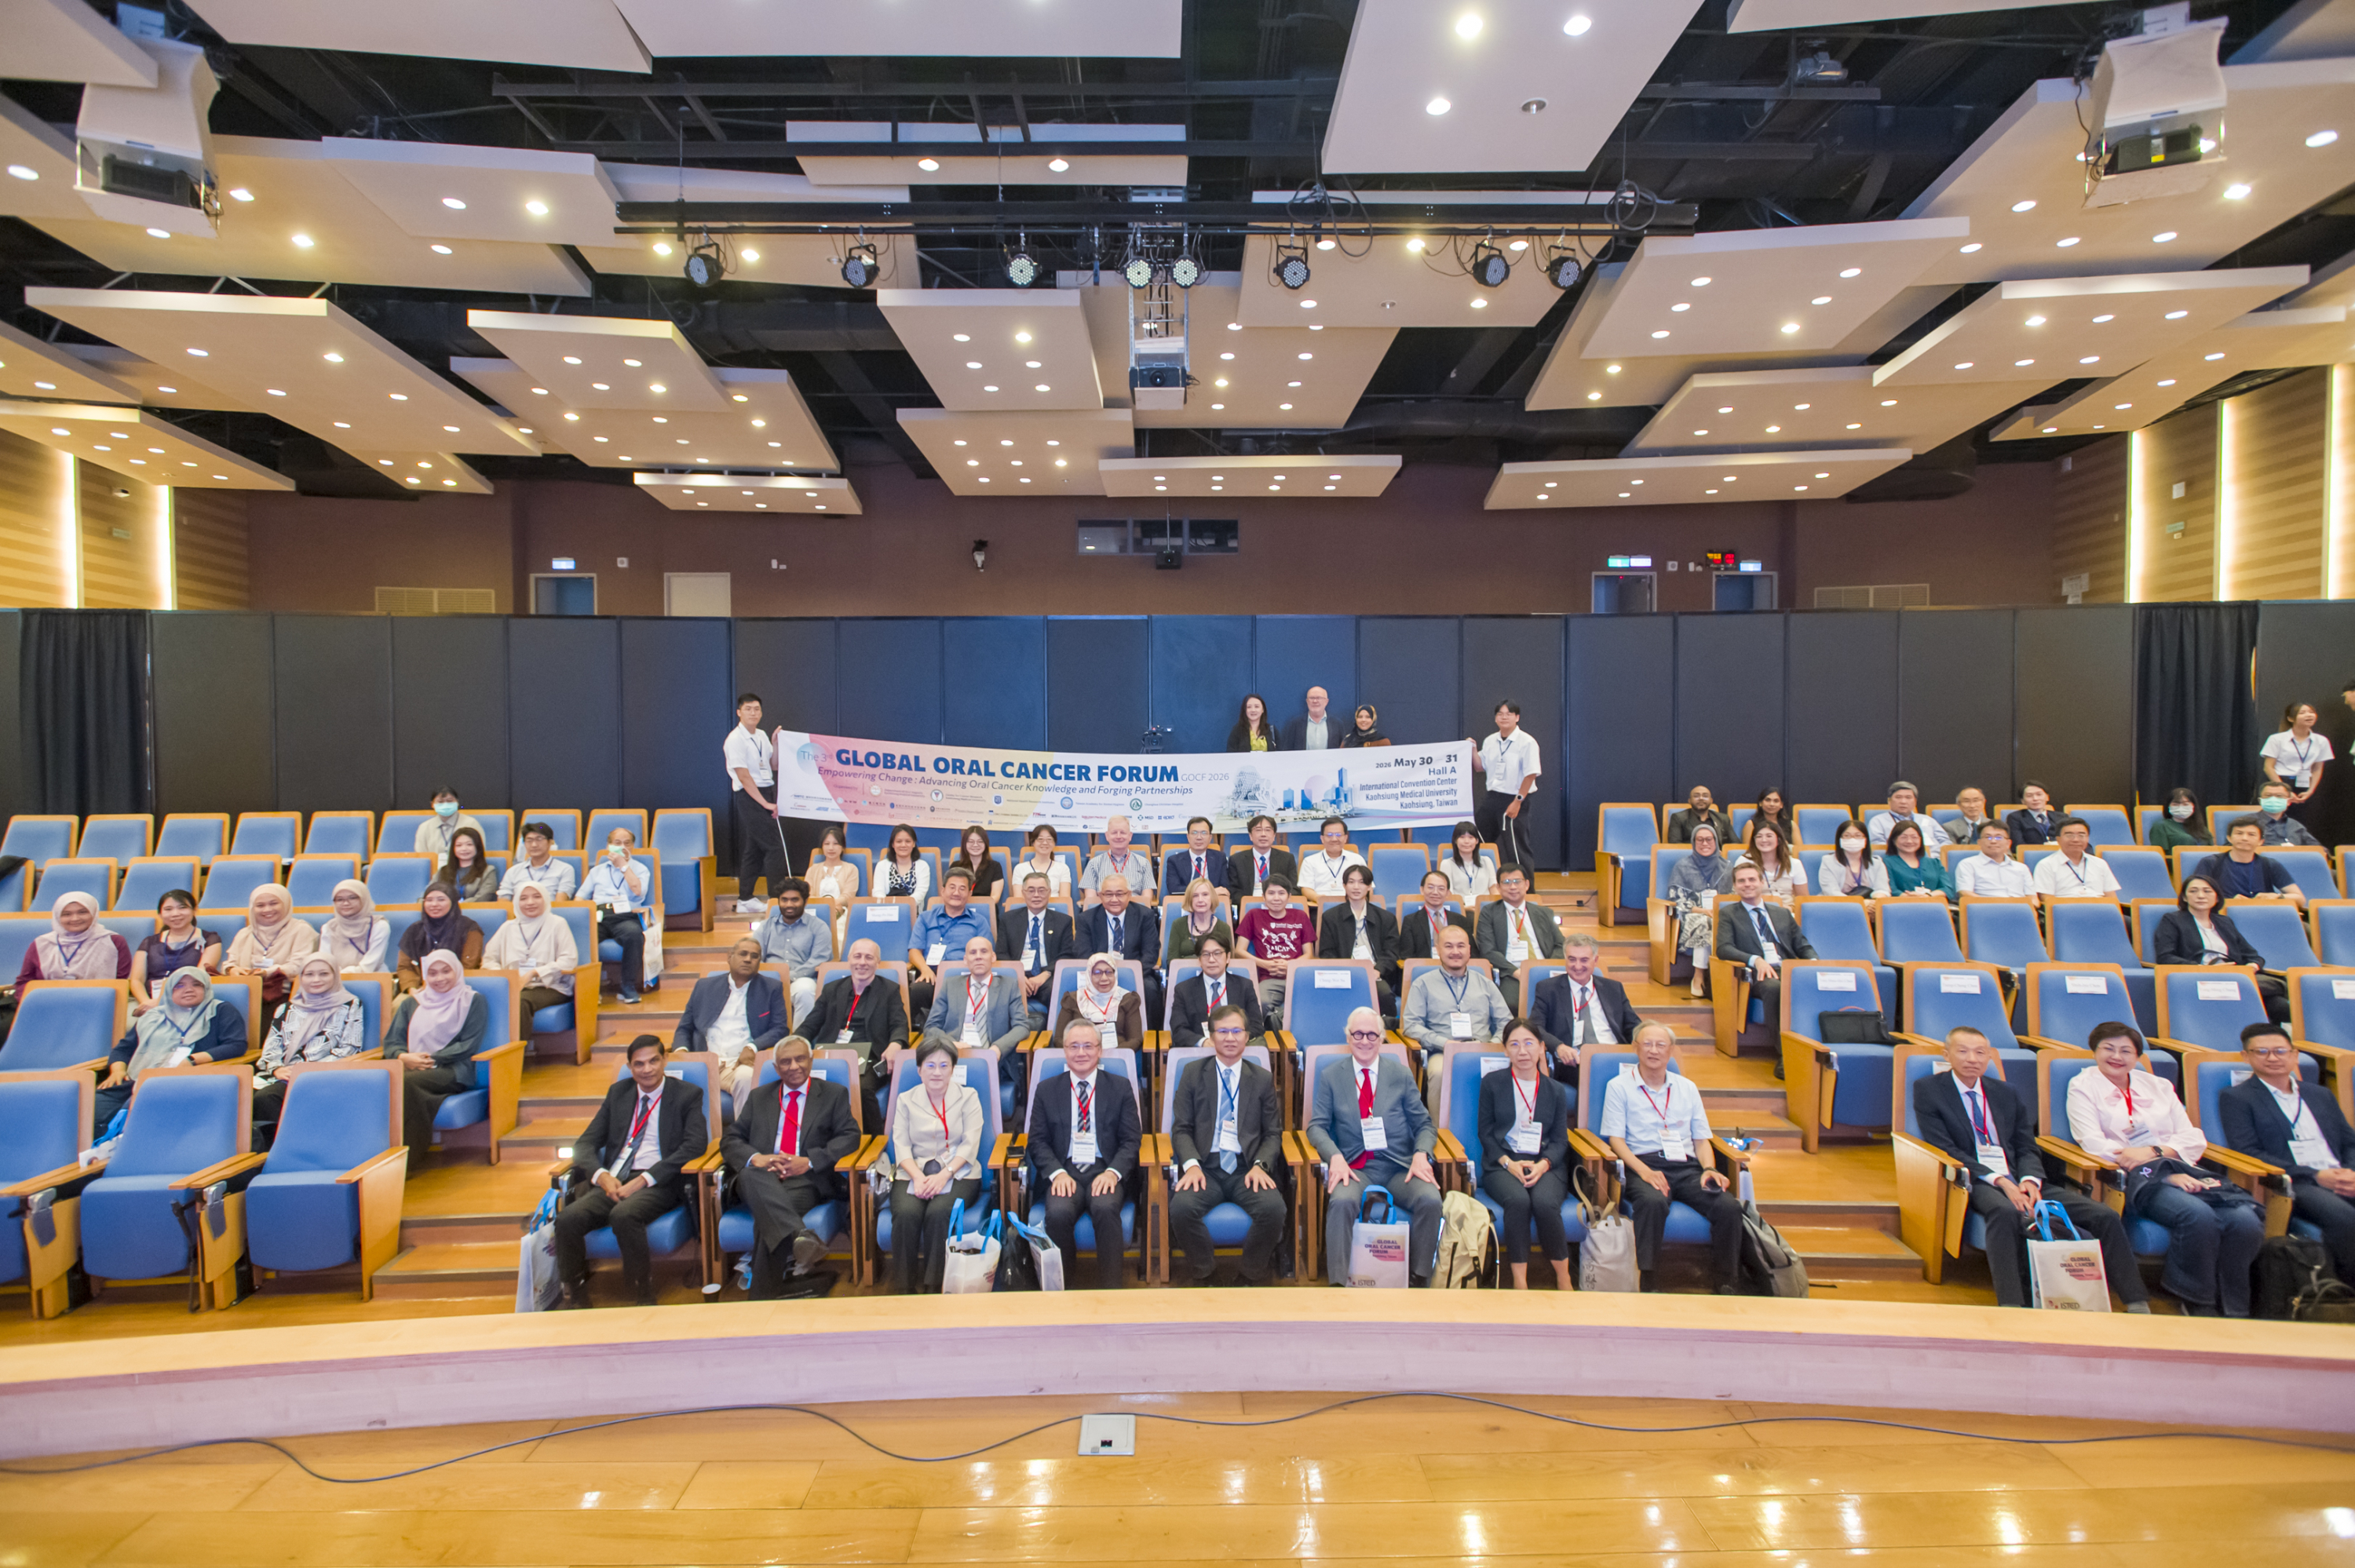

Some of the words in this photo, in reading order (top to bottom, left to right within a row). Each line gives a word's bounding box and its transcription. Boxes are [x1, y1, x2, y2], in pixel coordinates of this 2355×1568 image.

[801, 750, 819, 761] The
[836, 749, 926, 773] GLOBAL
[933, 757, 995, 777] ORAL
[1000, 761, 1092, 782] CANCER
[1097, 765, 1179, 782] FORUM
[1181, 773, 1206, 782] GOCF
[1208, 772, 1229, 781] 2026
[1393, 758, 1416, 768] May
[1418, 756, 1433, 765] 30
[1445, 754, 1458, 763] 31
[1428, 767, 1447, 775] Hall
[818, 766, 877, 782] Empowering
[919, 776, 967, 789] Advancing
[969, 779, 990, 789] Oral
[991, 782, 1024, 791] Cancer
[1025, 783, 1077, 795] Knowledge
[1097, 786, 1133, 796] Forging
[1134, 786, 1193, 796] Partnerships
[1360, 781, 1400, 791] International
[1400, 779, 1436, 789] Convention
[1365, 792, 1399, 801] Kaohsiung
[1400, 789, 1424, 799] Medical
[1425, 788, 1458, 797] University
[1400, 800, 1435, 810] Kaohsiung,
